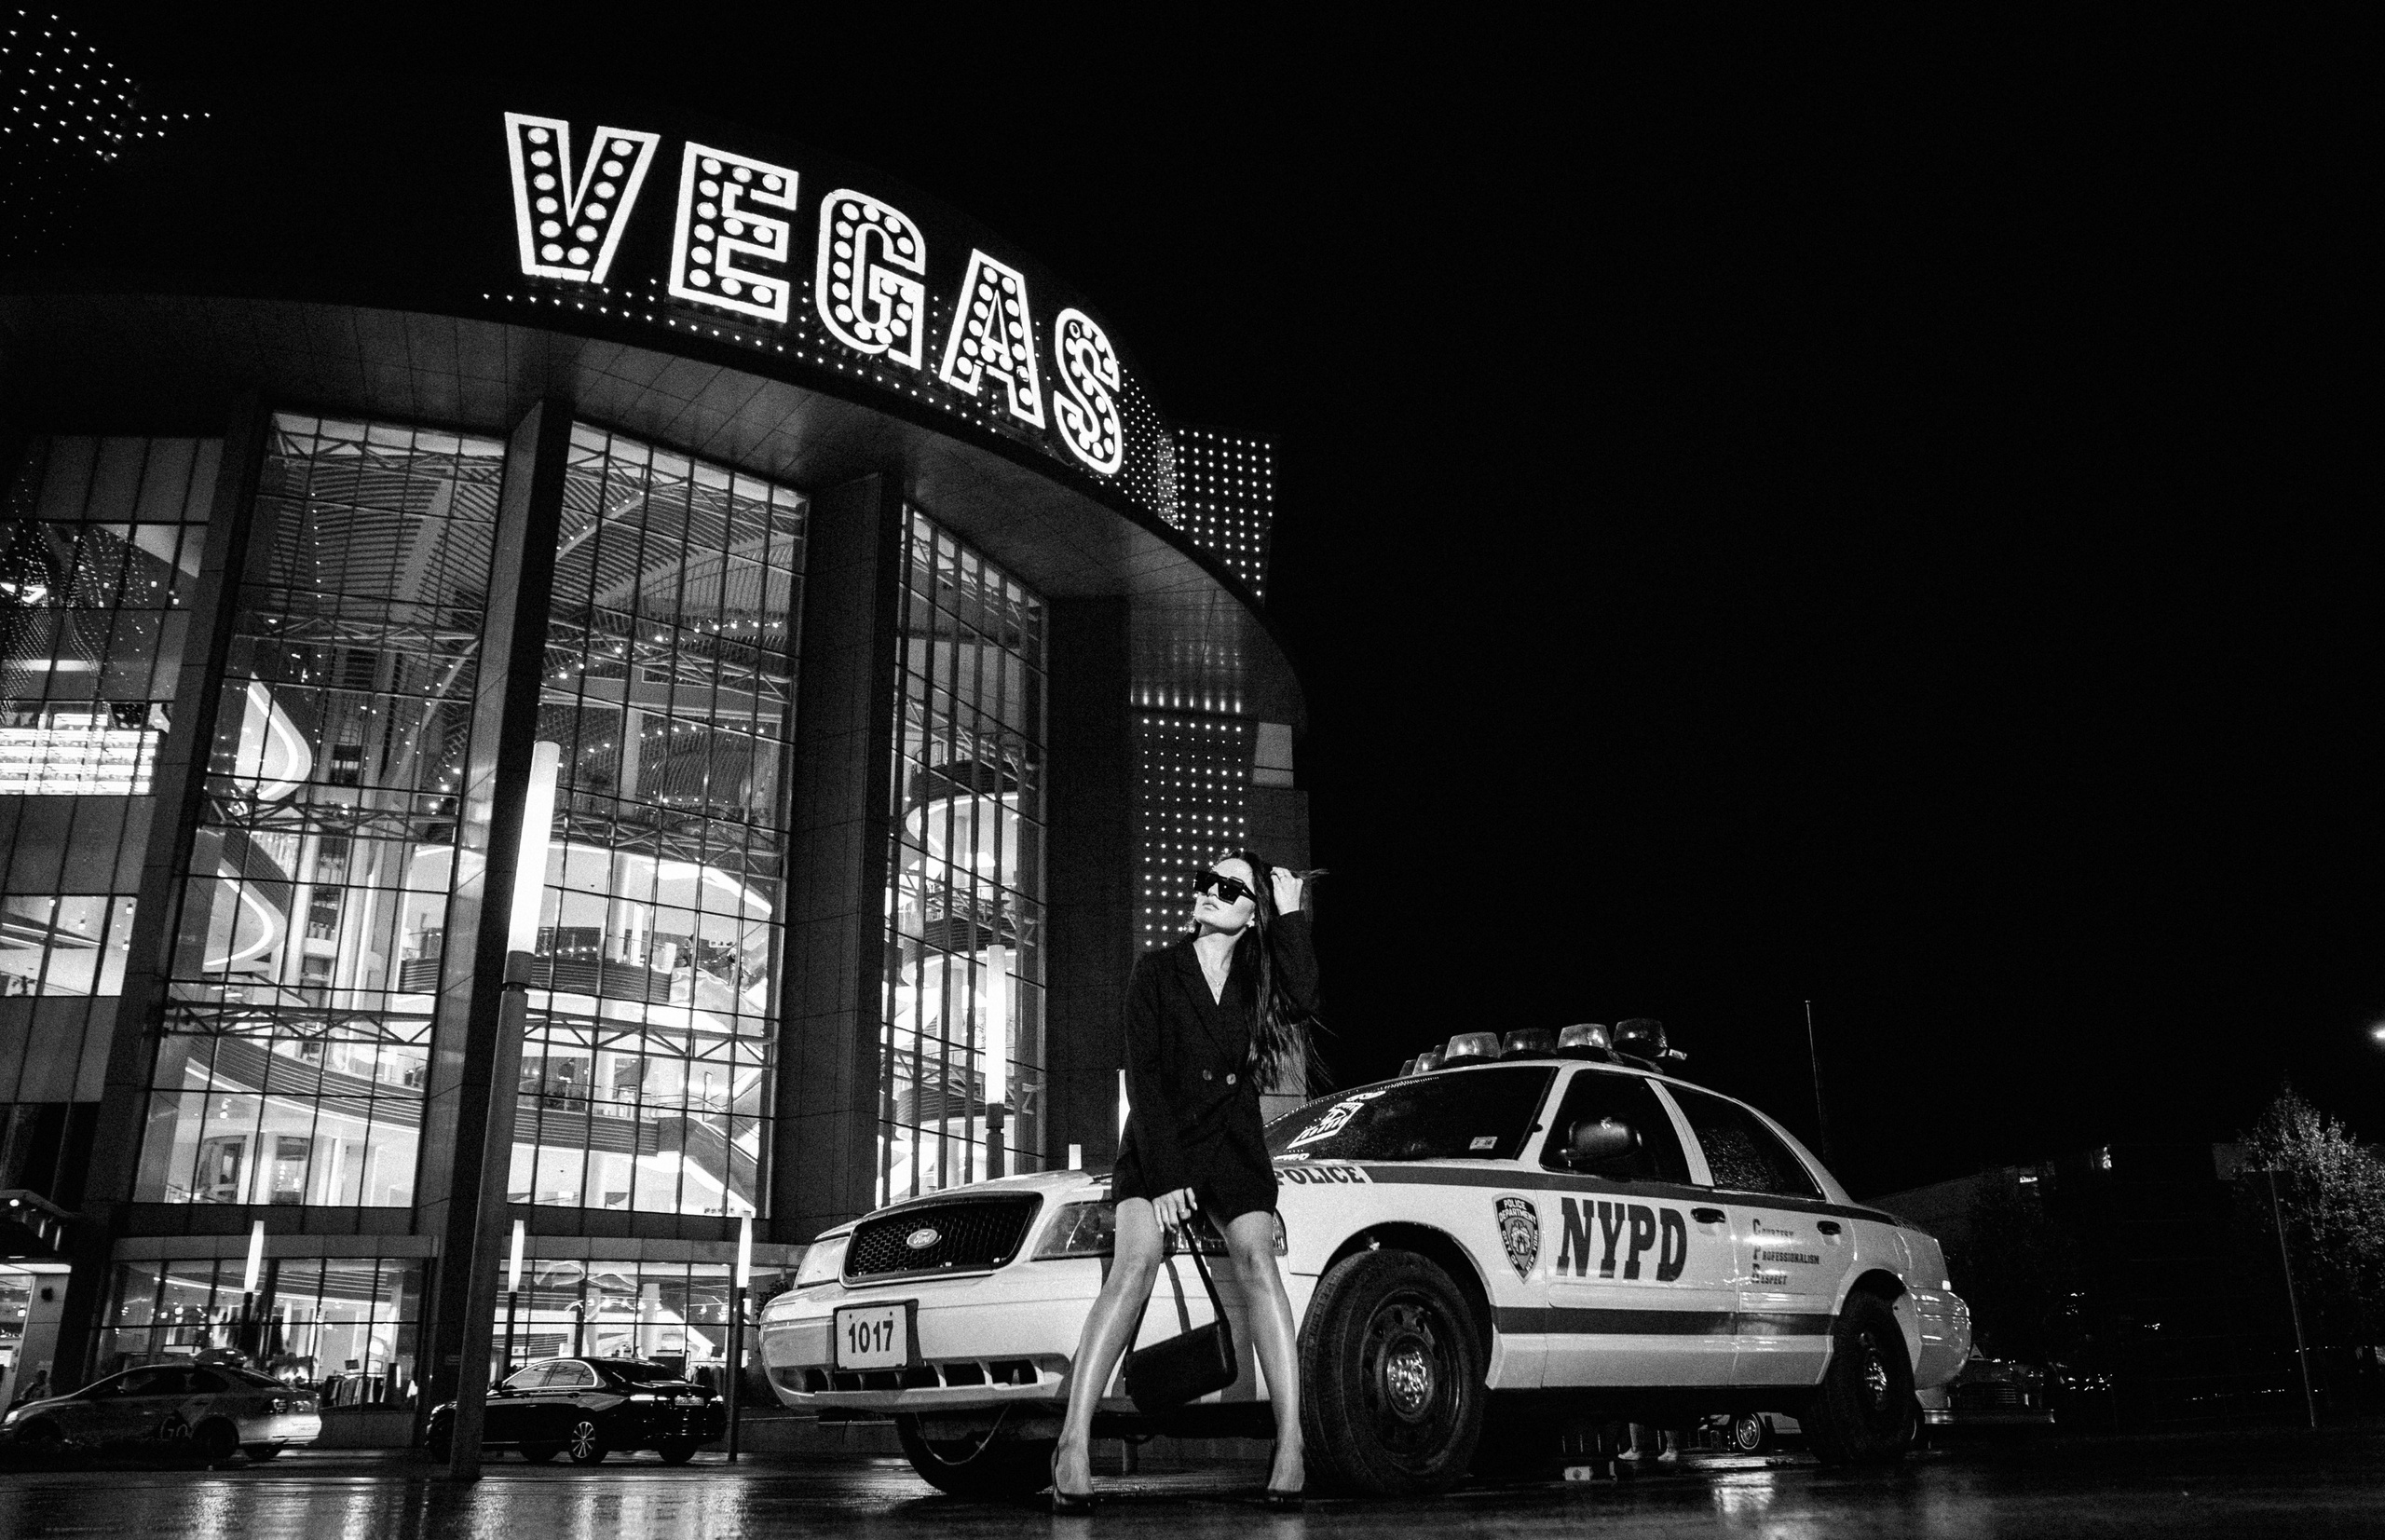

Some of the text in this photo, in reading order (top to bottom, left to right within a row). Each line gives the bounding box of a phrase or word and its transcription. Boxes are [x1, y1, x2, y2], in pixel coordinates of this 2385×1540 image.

[504, 112, 1123, 474] VEGAS
[1498, 1208, 1537, 1225] DEPARTMENT
[1503, 1198, 1527, 1210] POLICE
[1556, 1197, 1687, 1282] NYPD
[849, 1320, 893, 1354] 1017
